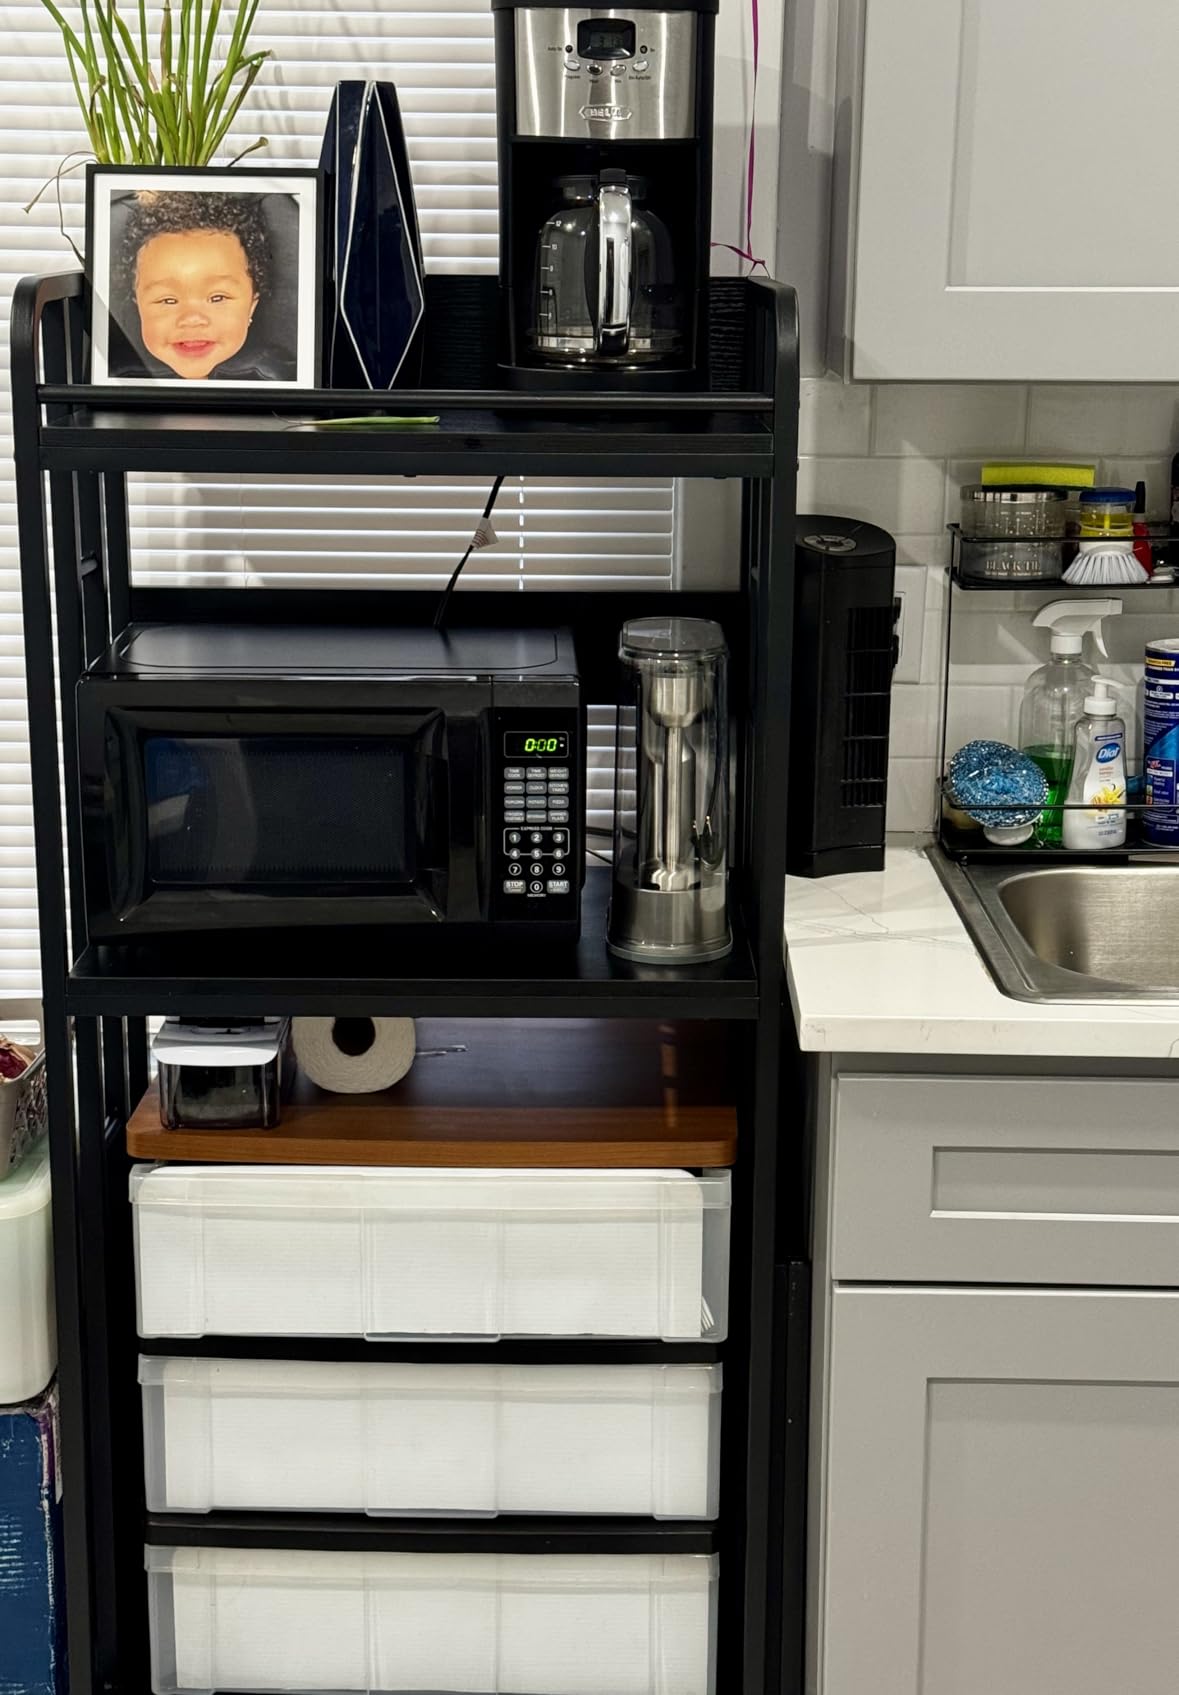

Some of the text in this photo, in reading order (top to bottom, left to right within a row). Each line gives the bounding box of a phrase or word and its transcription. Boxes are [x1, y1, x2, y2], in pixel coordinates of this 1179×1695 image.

[986, 560, 1021, 571] BLACK
[524, 738, 558, 751] 0:00
[1098, 746, 1120, 759] Dial
[512, 834, 517, 842] 1
[534, 834, 540, 842] 2
[534, 883, 540, 891] 0
